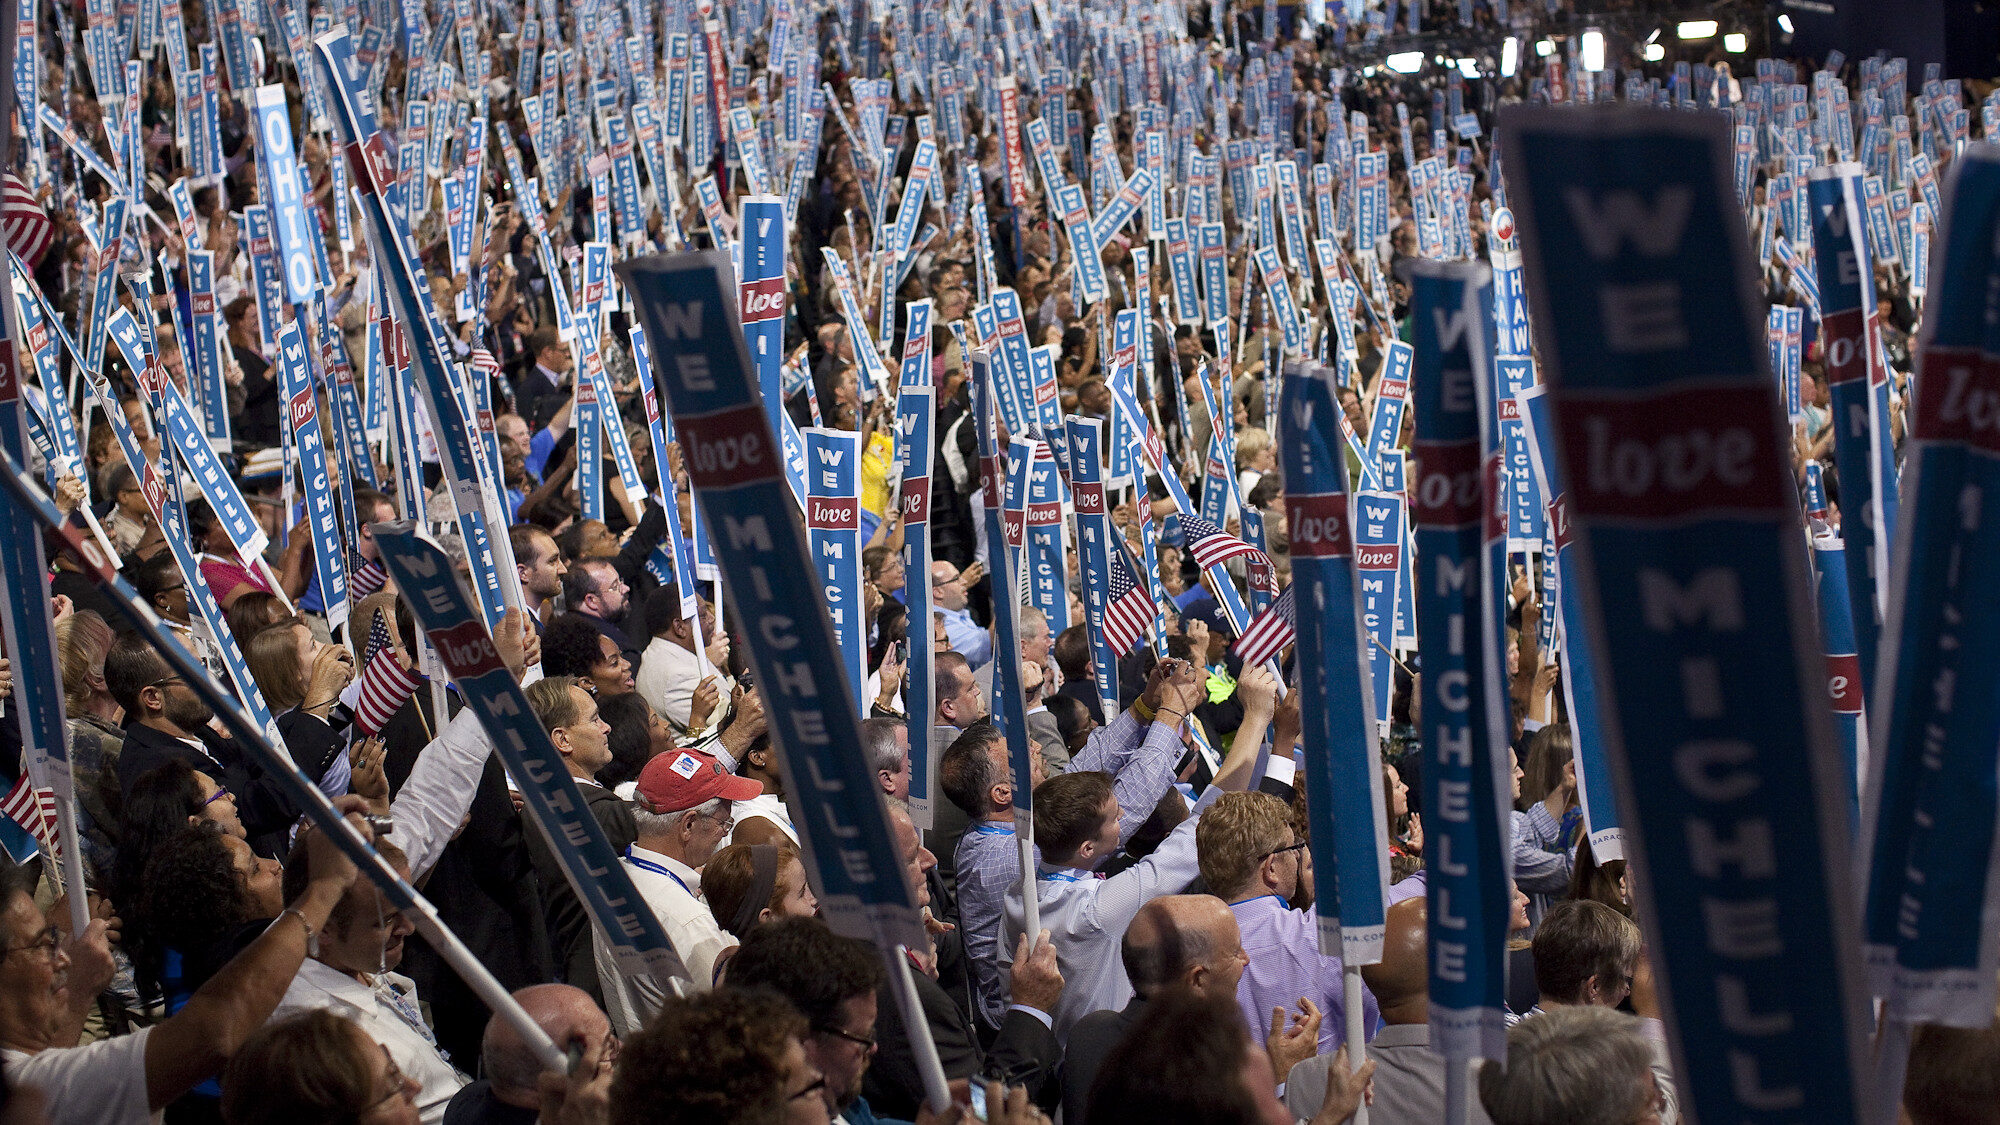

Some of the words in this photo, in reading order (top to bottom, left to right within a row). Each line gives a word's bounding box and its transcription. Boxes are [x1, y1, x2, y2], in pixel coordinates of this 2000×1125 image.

[1002, 89, 1025, 205] PENNSYLVANIA
[266, 110, 312, 297] OHIO
[1062, 192, 1078, 210] WE
[1073, 225, 1100, 291] MICHELLE
[1175, 256, 1194, 317] MICHELLE
[1209, 260, 1222, 318] MICHELLE
[1563, 184, 1692, 352] WE
[995, 296, 1012, 318] WE
[285, 342, 306, 383] WE
[653, 301, 717, 394] WE
[1036, 356, 1049, 379] WE
[1395, 351, 1409, 377] WE
[992, 355, 1019, 432] MICHELLE
[1008, 340, 1037, 419] MICHELLE
[1038, 384, 1055, 400] love
[1382, 383, 1405, 395] love
[1504, 366, 1527, 394] WE
[167, 396, 248, 536] MICHELLE
[341, 390, 371, 481] MICHELL
[580, 411, 592, 513] MICHELLE
[687, 430, 760, 474] love
[1586, 416, 1757, 498] love
[817, 447, 843, 488] WE
[1032, 470, 1049, 497] WE
[1384, 461, 1397, 488] WE
[1511, 427, 1532, 533] MICHELLE
[304, 429, 345, 595] MICHELLE
[814, 502, 851, 522] love
[1028, 507, 1056, 522] love
[1366, 505, 1391, 539] WE
[395, 550, 456, 614] WE
[1357, 549, 1393, 565] love
[1082, 524, 1108, 689] MICHELLE
[445, 638, 496, 668] love
[726, 514, 876, 884] MICHELLE
[1434, 555, 1478, 982] MICHELLE
[489, 693, 645, 938] MICHELLE
[1635, 566, 1806, 1112] MICHELL
